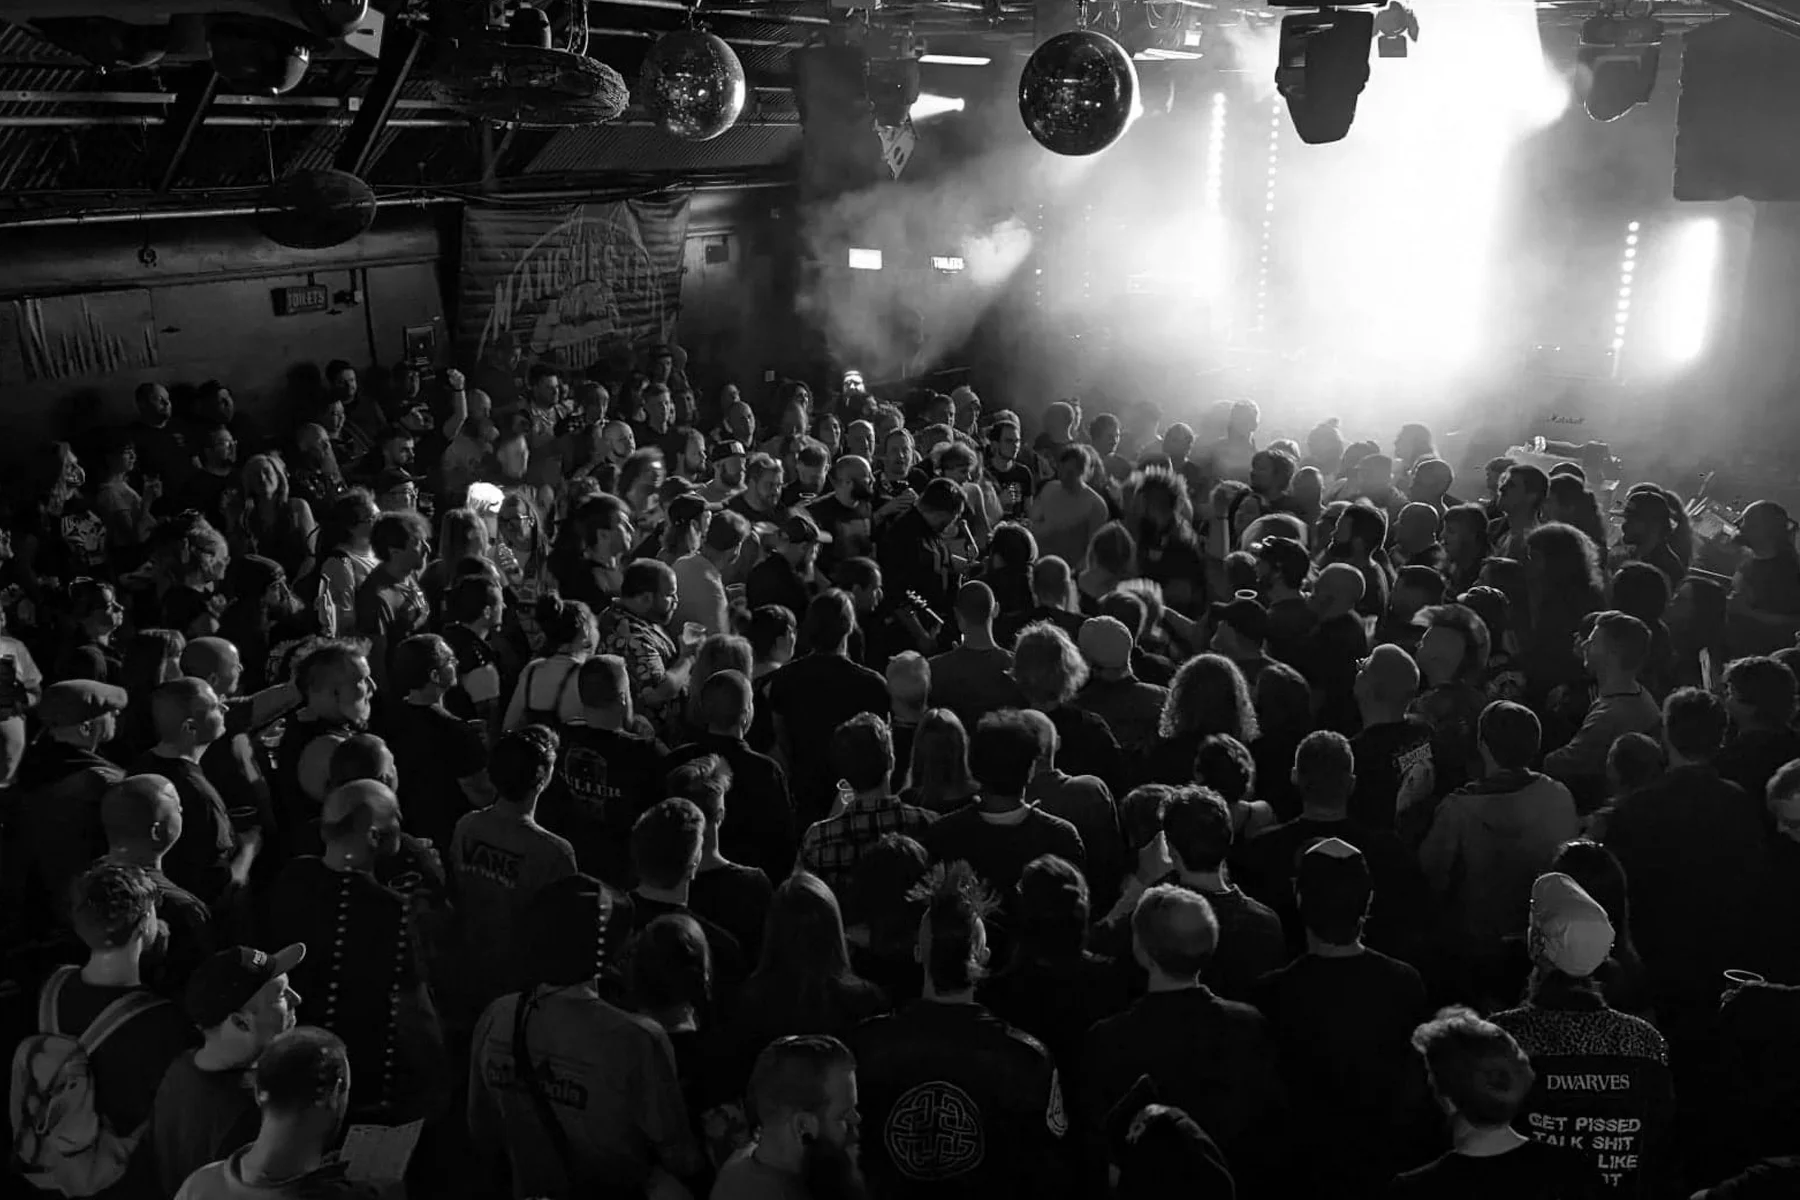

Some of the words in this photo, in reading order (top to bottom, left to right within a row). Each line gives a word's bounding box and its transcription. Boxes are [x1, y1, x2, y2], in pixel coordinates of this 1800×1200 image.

[1546, 1073, 1630, 1092] DWARVES
[1527, 1112, 1568, 1132] GET
[1574, 1116, 1641, 1133] PISSED
[1591, 1136, 1634, 1151] SHIT
[1597, 1153, 1639, 1170] LIKE
